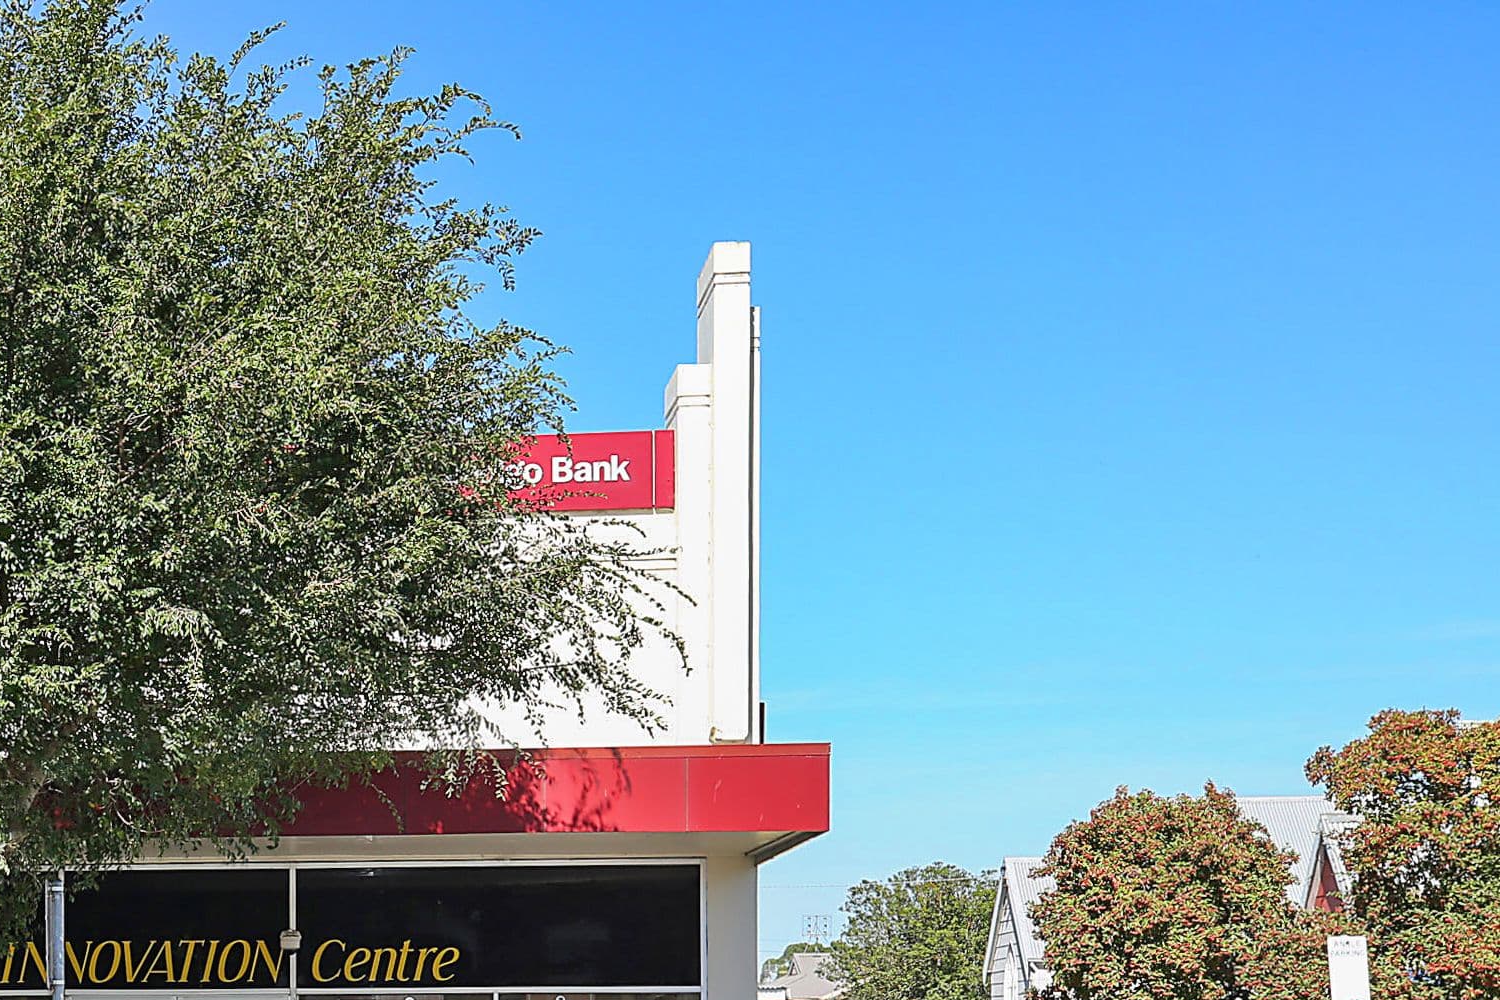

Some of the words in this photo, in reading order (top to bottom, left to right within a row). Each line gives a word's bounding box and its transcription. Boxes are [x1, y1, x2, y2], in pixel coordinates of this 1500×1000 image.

[551, 454, 631, 484] Bank
[0, 939, 287, 985] INNOVATION
[311, 938, 461, 984] Centre
